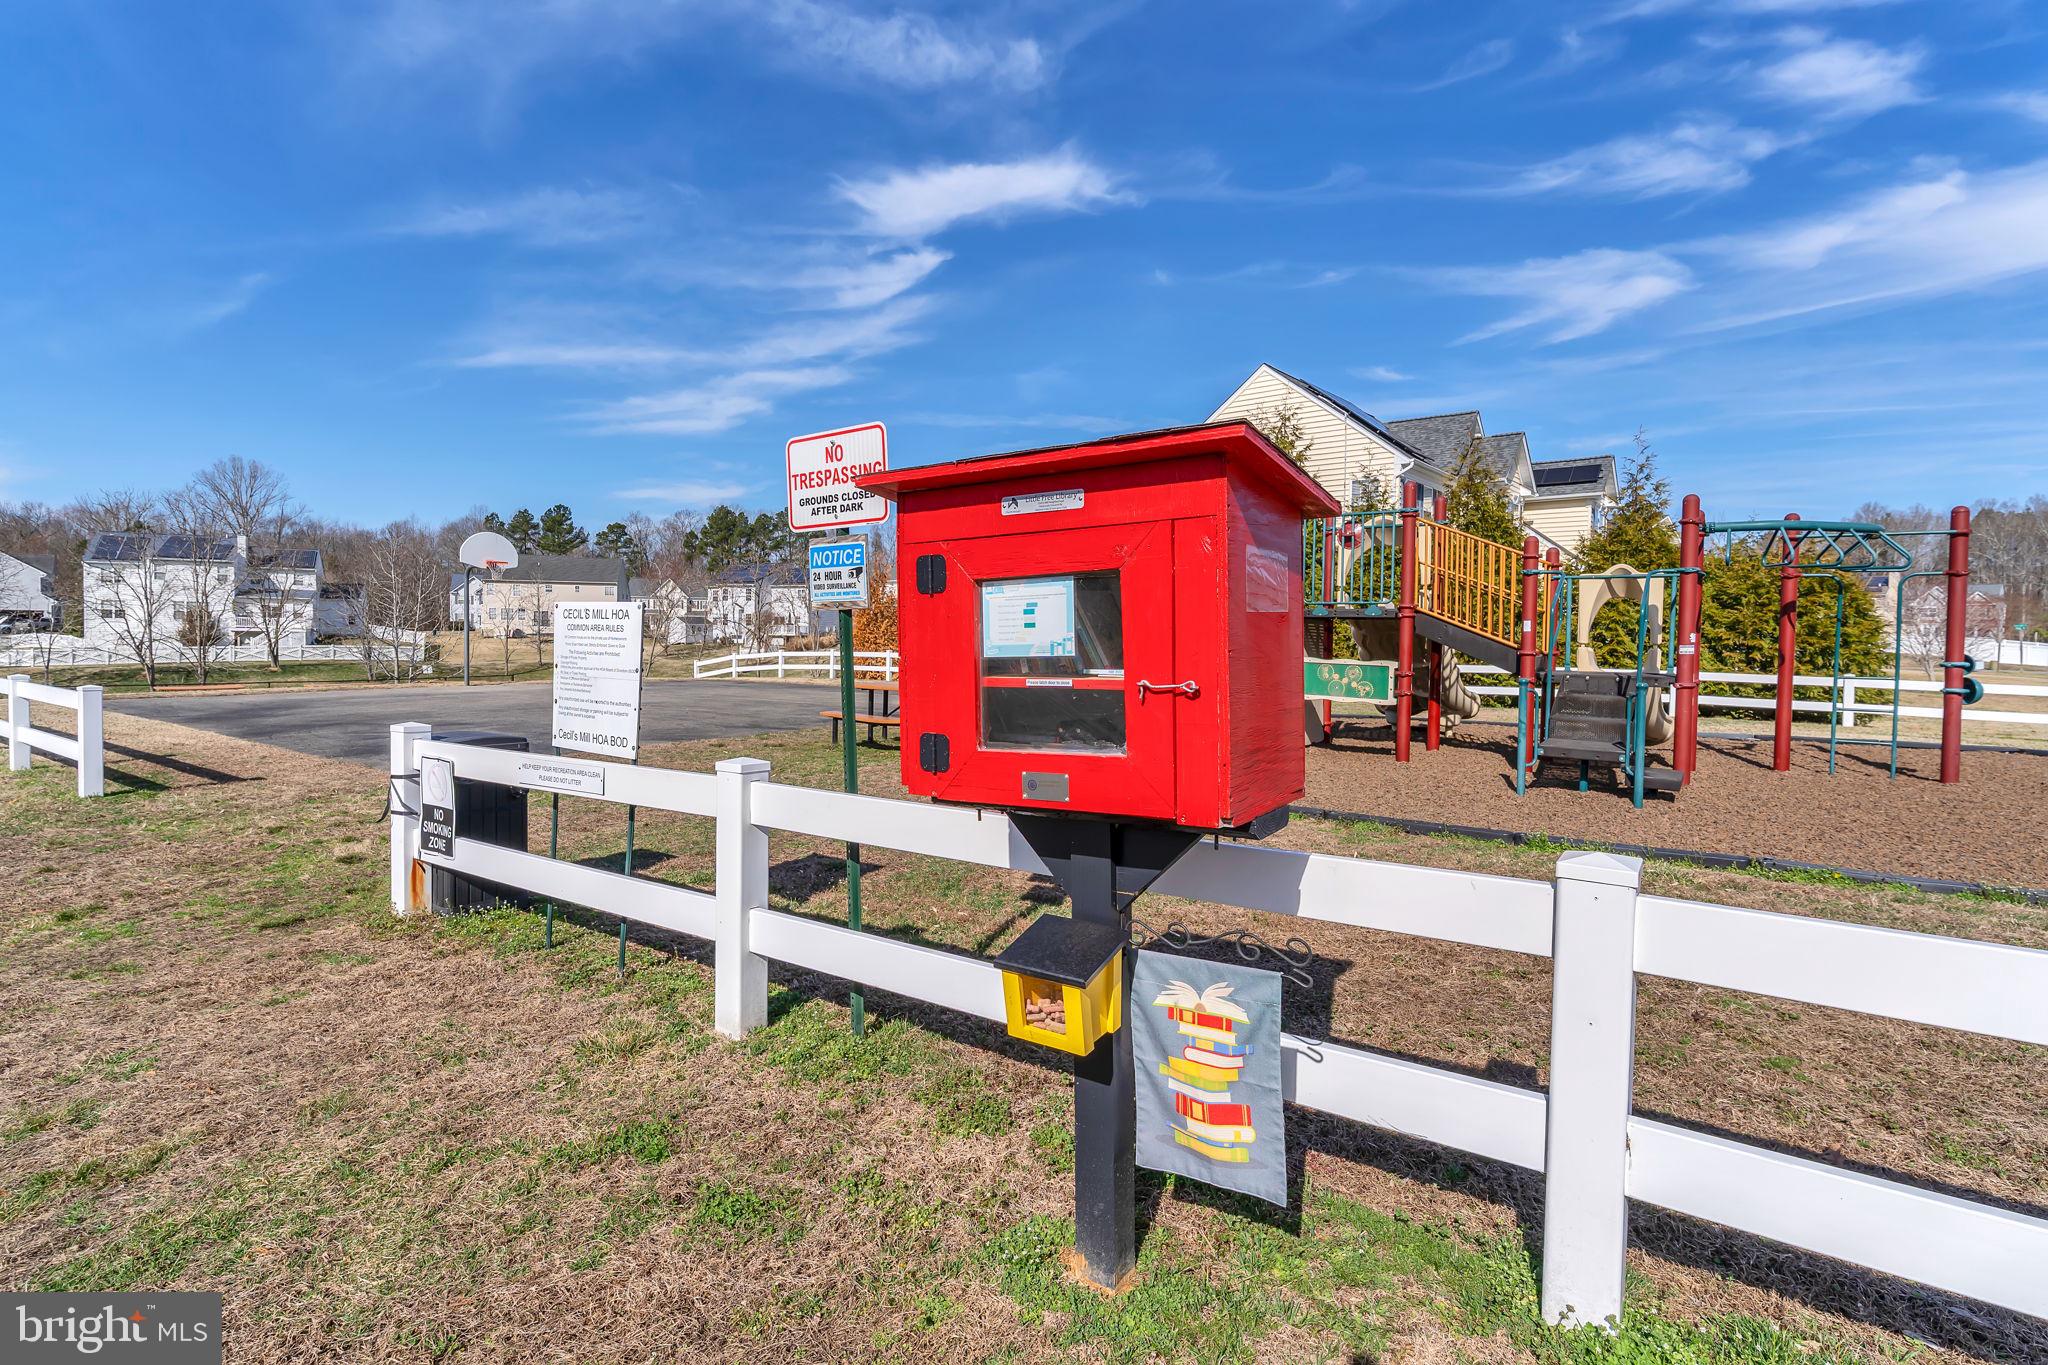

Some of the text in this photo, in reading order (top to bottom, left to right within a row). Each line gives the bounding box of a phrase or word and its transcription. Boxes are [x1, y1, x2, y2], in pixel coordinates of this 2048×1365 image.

[825, 444, 843, 463] NO
[792, 461, 882, 490] TRESPASSING
[799, 490, 876, 507] GROUNDS CLOSED
[1055, 492, 1077, 501] Library
[811, 502, 864, 517] AFTER DARK
[813, 549, 861, 566] NOTICE
[813, 571, 842, 581] 24 HOUR
[826, 582, 857, 590] SURVEILLANCE
[562, 608, 630, 620] CECIL'S MILL HOA
[566, 623, 625, 633] COMMON AREA RULES
[558, 728, 628, 748] Cecil's Mill HOA BOD
[552, 766, 576, 775] RECREATION
[538, 775, 553, 783] PLEASE
[568, 778, 582, 786] LITTER
[434, 808, 444, 822] NO
[423, 820, 452, 839] SMOKING
[428, 836, 447, 851] ZONE
